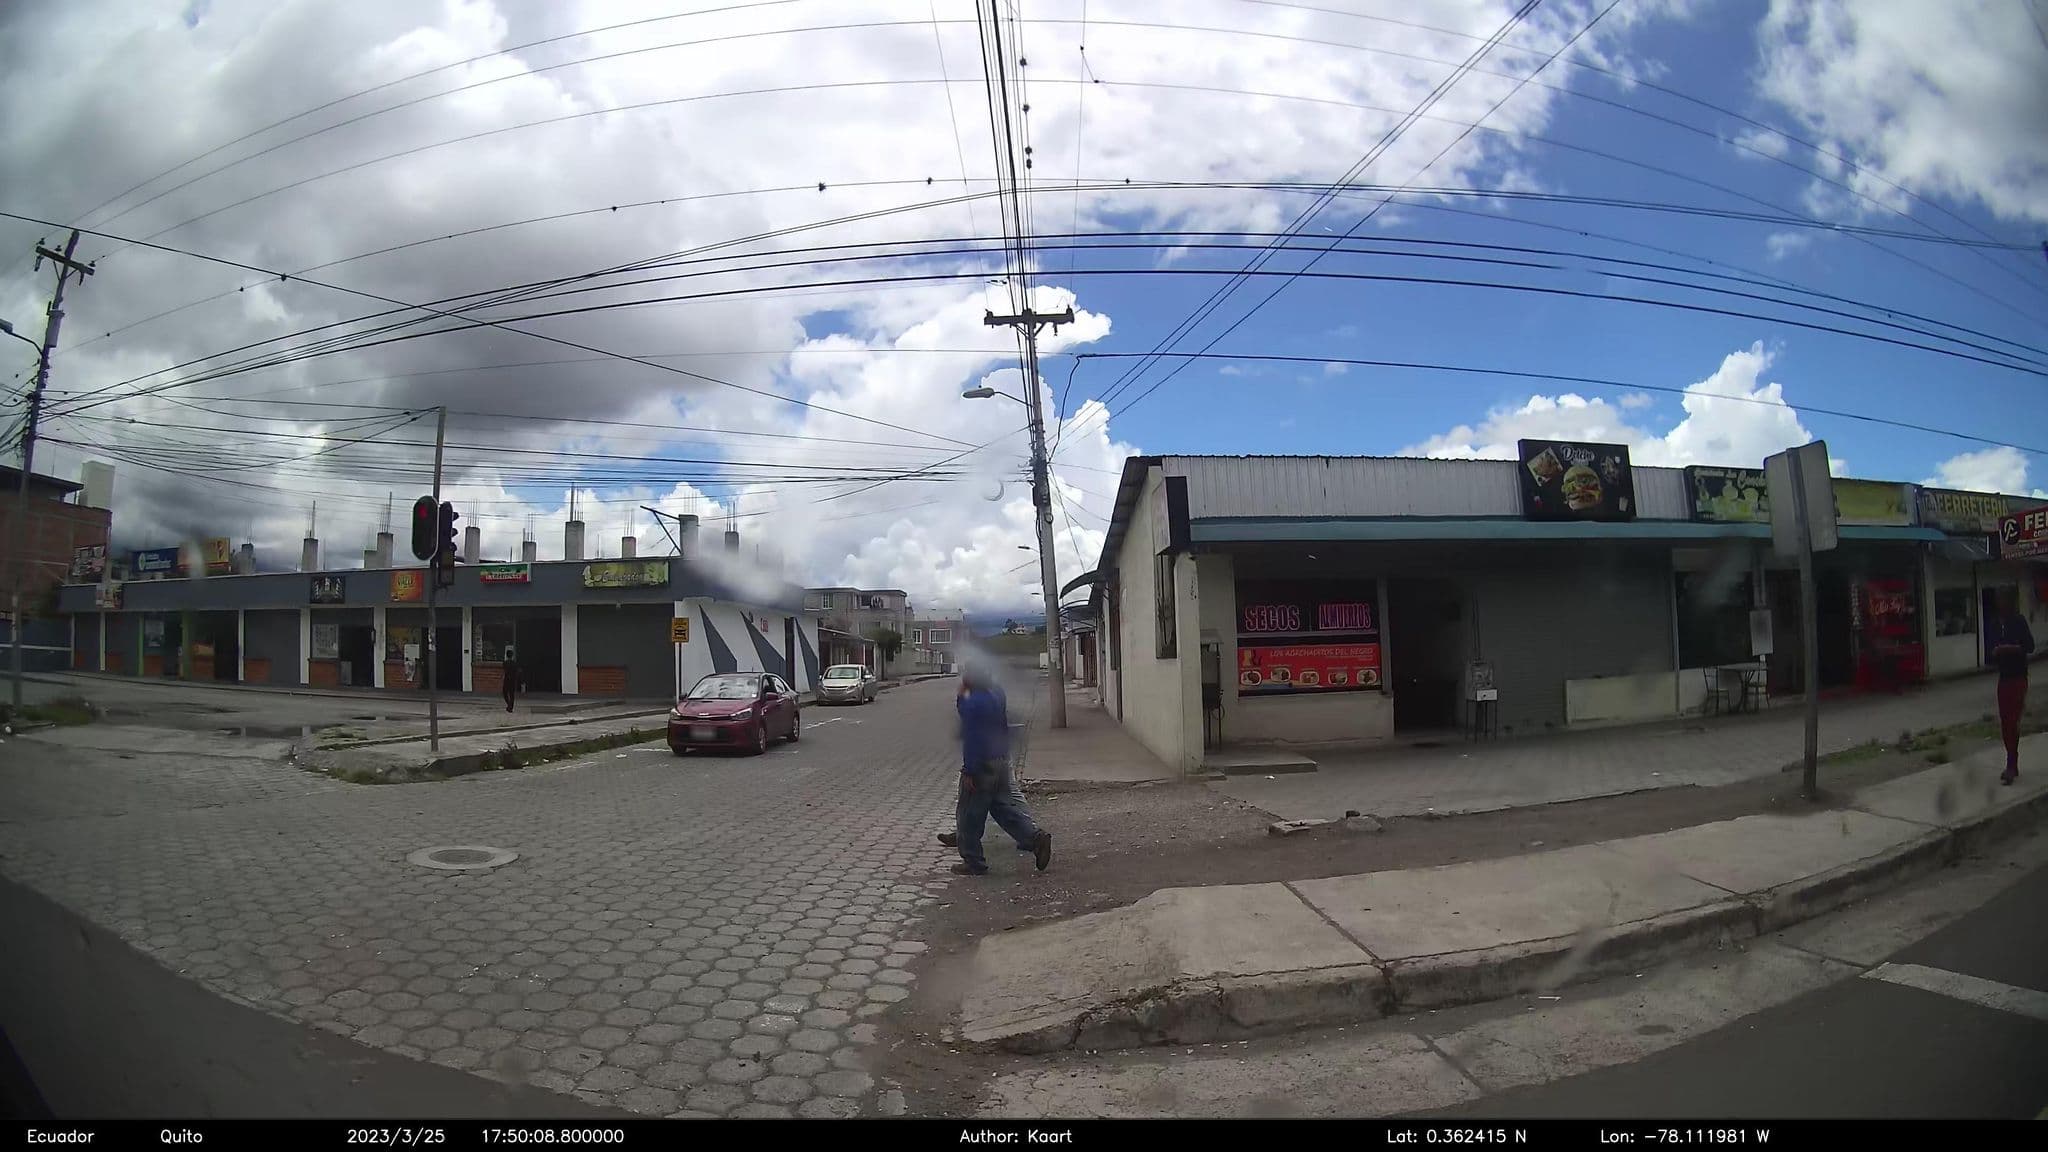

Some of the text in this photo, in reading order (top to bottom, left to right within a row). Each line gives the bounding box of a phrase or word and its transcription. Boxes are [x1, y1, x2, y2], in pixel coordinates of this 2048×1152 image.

[1937, 493, 2009, 517] FERRETERIA
[1245, 604, 1372, 631] SECOS ALMUERZOS
[1335, 647, 1349, 656] DEL
